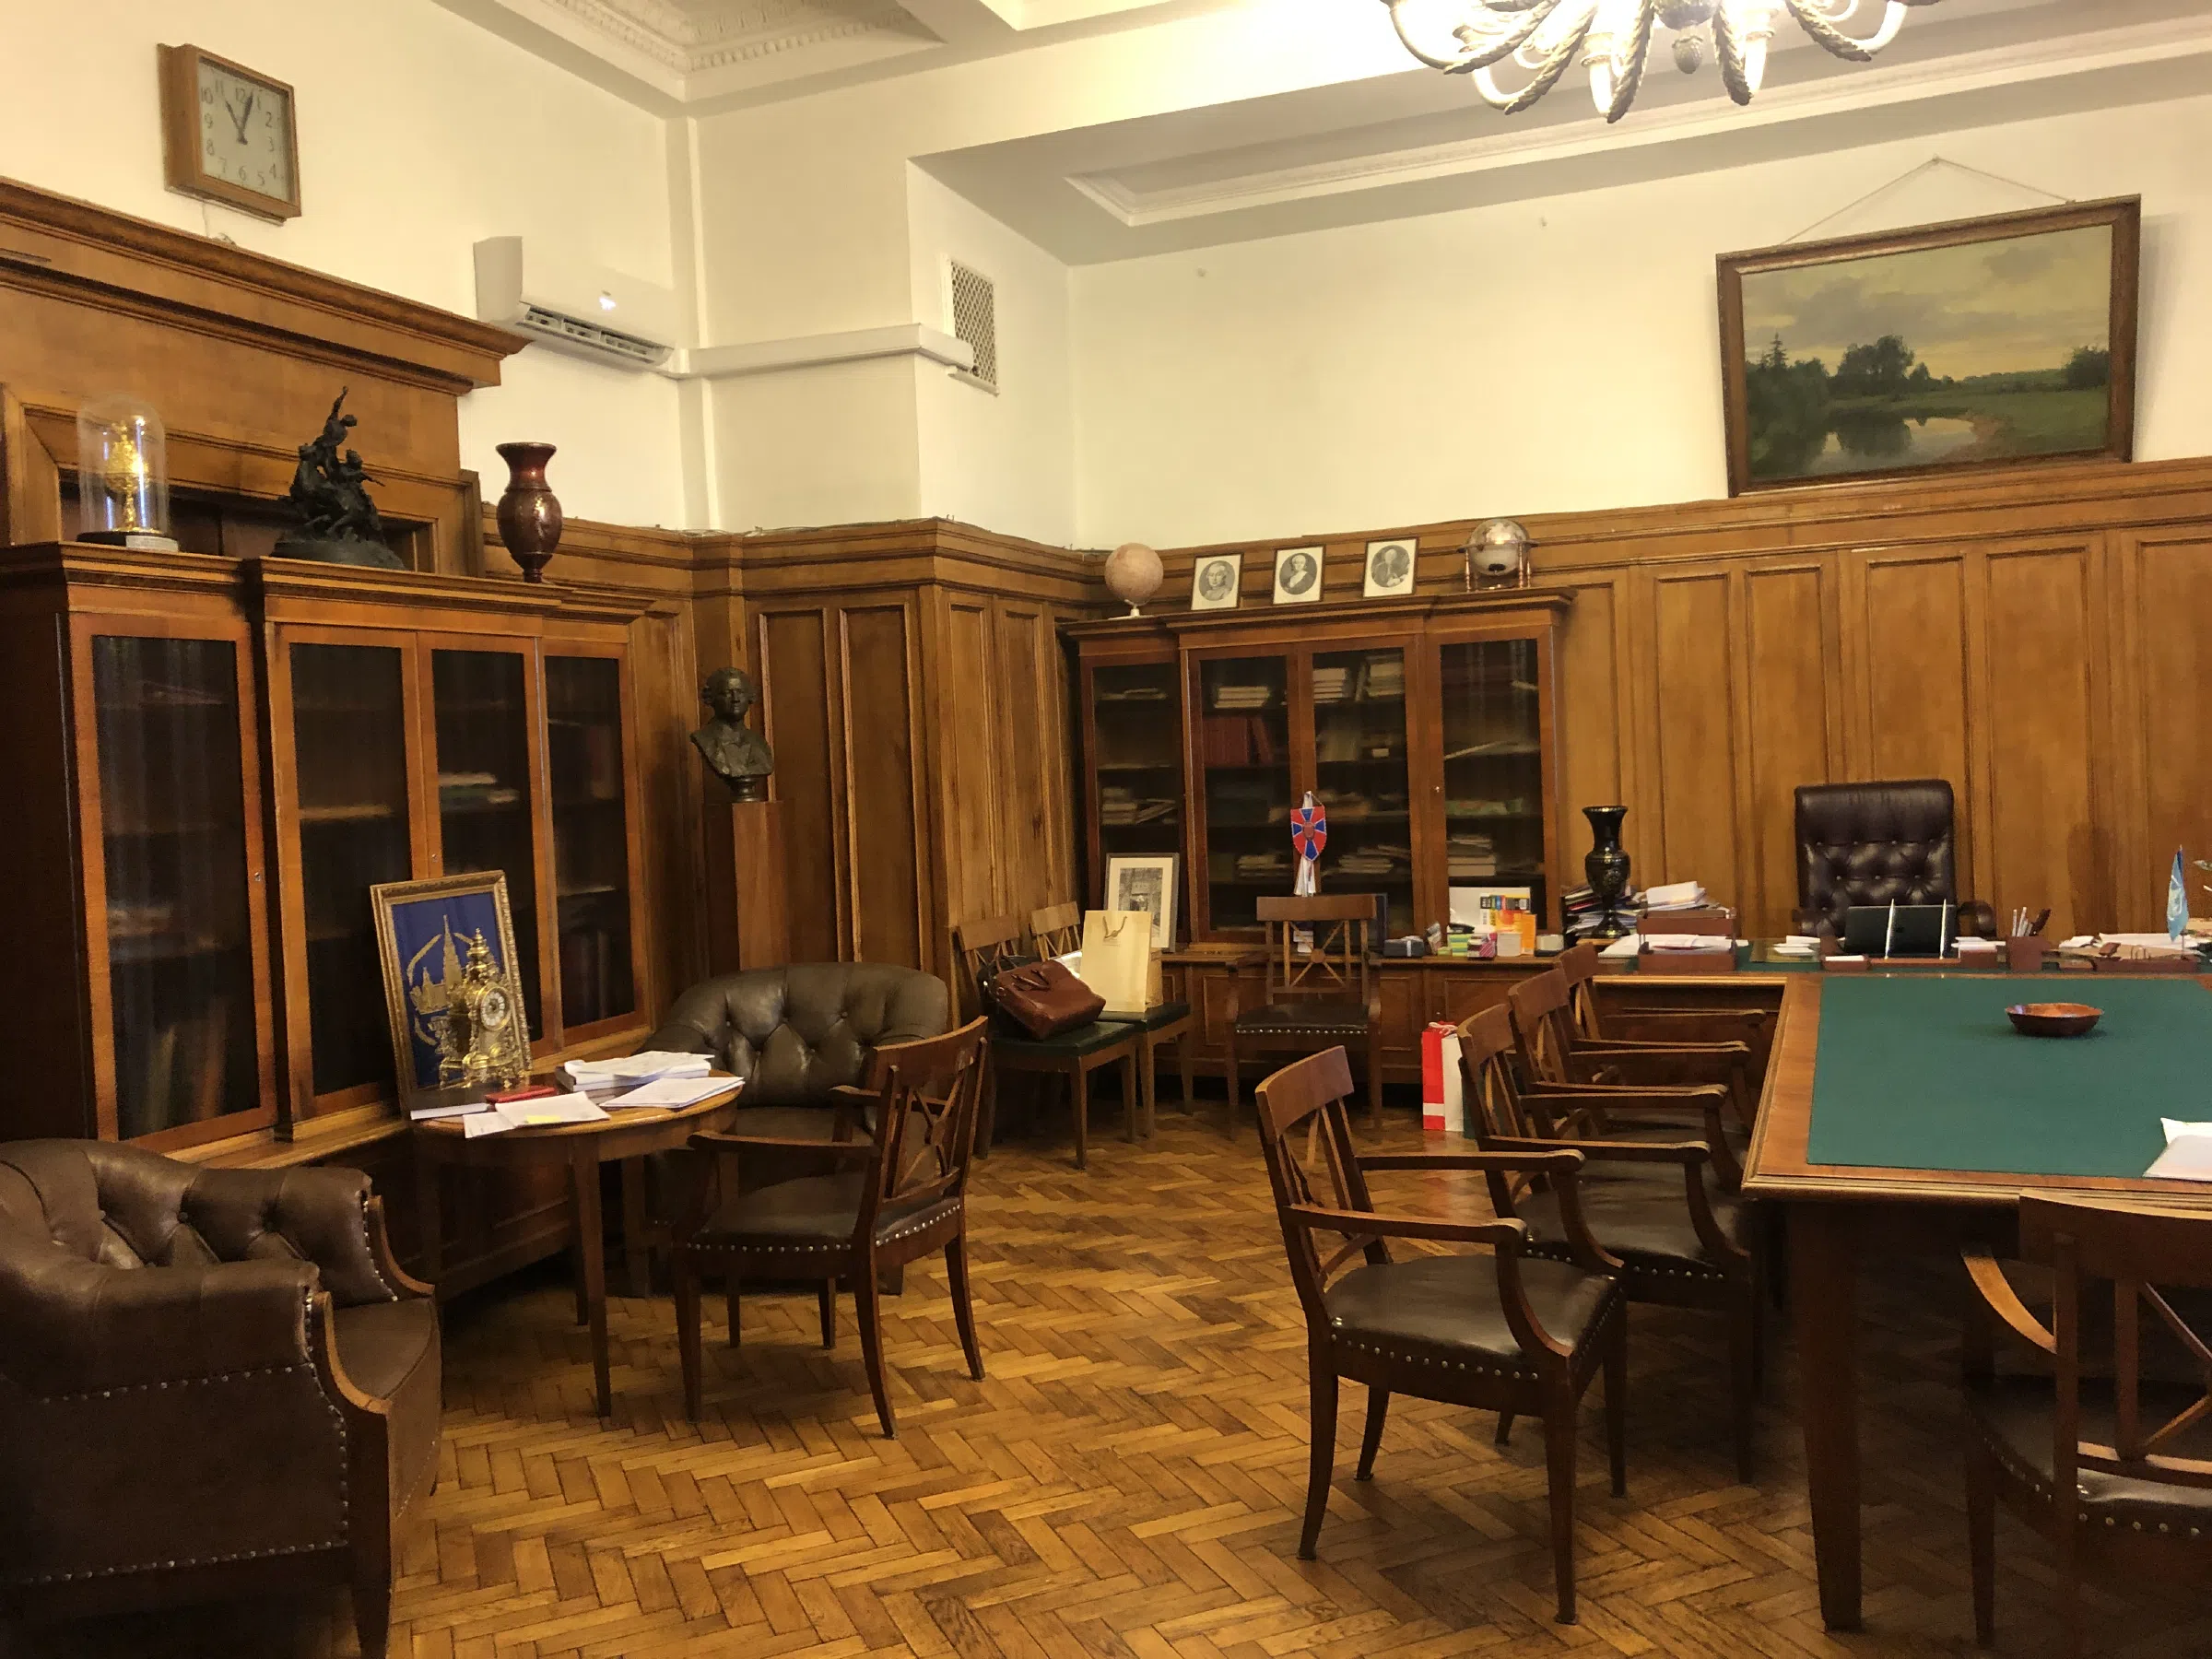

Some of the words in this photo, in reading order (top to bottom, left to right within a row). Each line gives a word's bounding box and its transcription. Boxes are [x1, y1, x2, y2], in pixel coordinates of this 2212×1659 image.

[215, 79, 224, 95] 11
[201, 88, 214, 104] 10
[236, 88, 246, 104] 12
[204, 112, 214, 129] 9
[265, 112, 273, 128] 2
[206, 139, 215, 156] 8
[267, 136, 275, 152] 3
[218, 157, 228, 173] 7
[238, 165, 247, 181] 6
[269, 163, 276, 179] 4
[257, 171, 265, 186] 5
